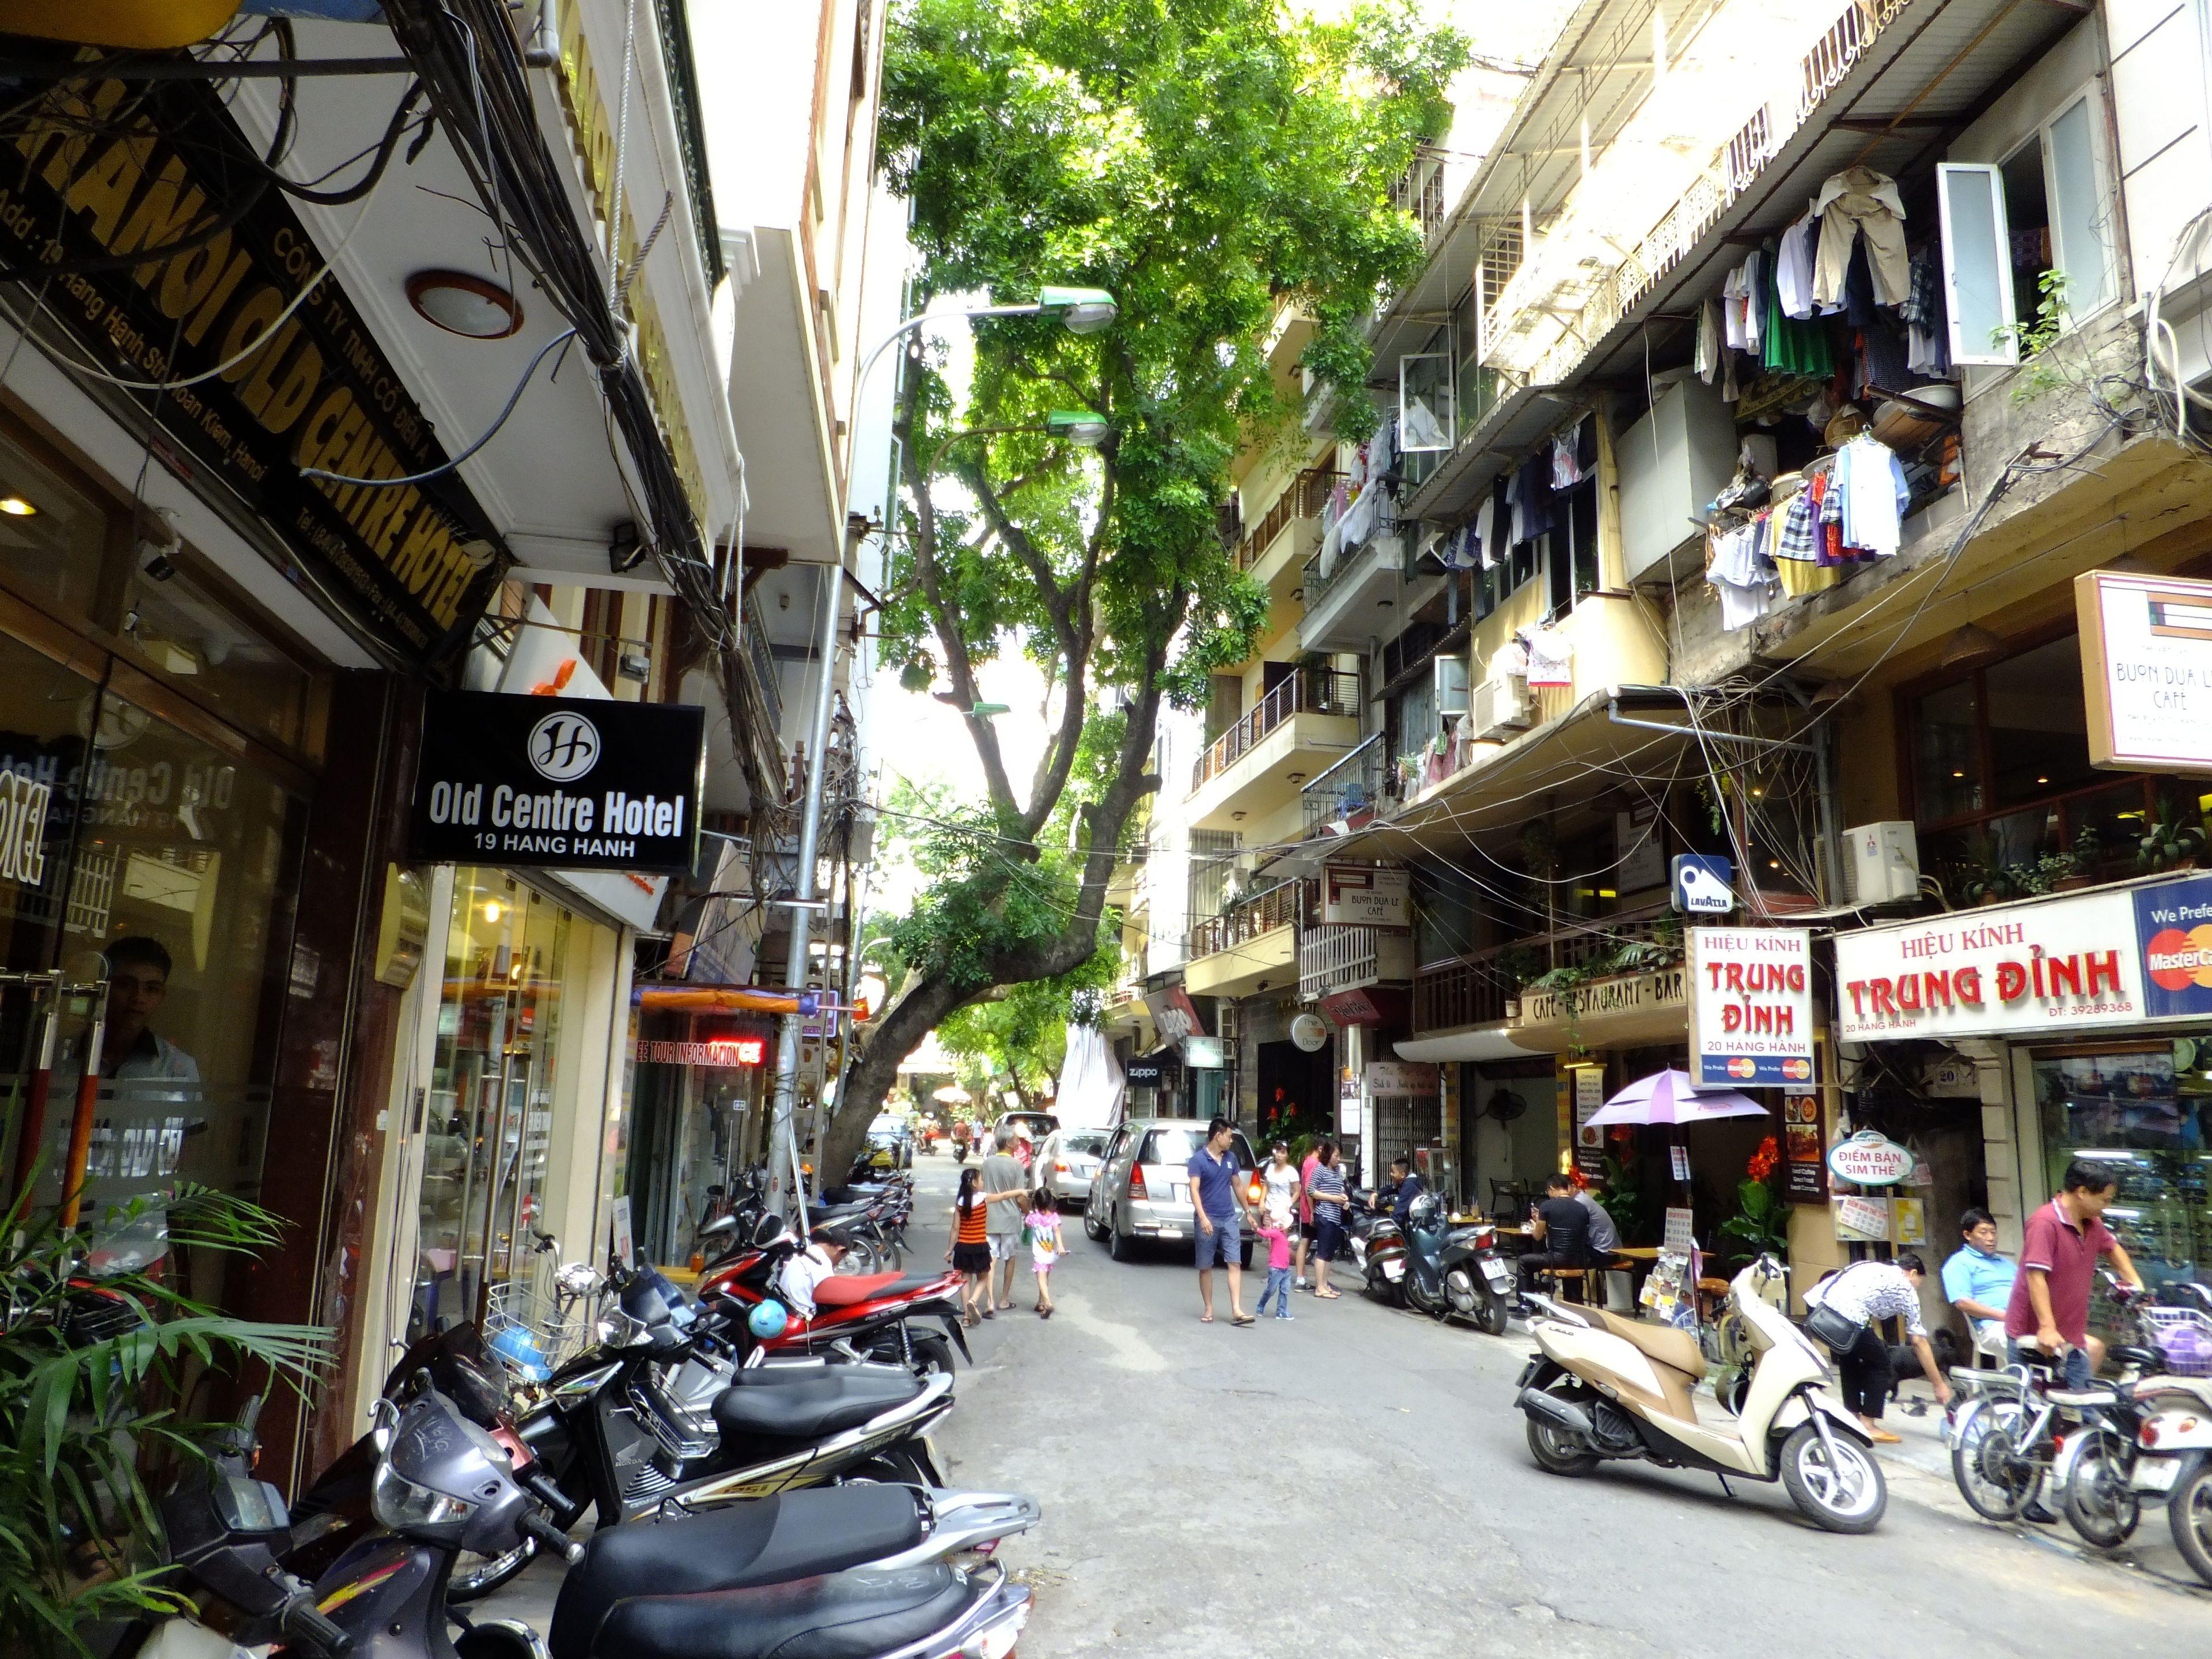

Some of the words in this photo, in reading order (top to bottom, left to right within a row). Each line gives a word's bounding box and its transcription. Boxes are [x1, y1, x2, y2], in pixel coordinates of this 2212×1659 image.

[273, 227, 327, 305] CÔNG
[219, 286, 323, 434] OLD
[294, 386, 421, 567] CENTRE
[397, 504, 485, 631] HOTEL
[429, 781, 483, 825] Old
[491, 785, 594, 832] Centre
[603, 791, 684, 837] Hotel
[474, 833, 497, 850] 19
[503, 835, 567, 854] HANG
[573, 839, 635, 858] HANH
[1691, 896, 1728, 908] LAVAZZA
[2152, 910, 2176, 923] We
[1705, 934, 1748, 954] HIỆU
[1756, 935, 1801, 952] KÍNH
[1902, 932, 1953, 960] HIỆU
[1961, 923, 2024, 950] KÍNH
[1655, 972, 1683, 1001] BAR
[1706, 963, 1804, 992] TRUNG
[1847, 965, 1983, 1016] TRUNG
[2049, 1006, 2067, 1017] ĐT:
[2070, 1002, 2133, 1016] 39289368
[1846, 1024, 1856, 1032] 20
[1302, 1037, 1320, 1046] Door
[1707, 1041, 1722, 1051] 20
[650, 1041, 676, 1063] TOUR
[676, 1041, 740, 1067] INFORMATION
[1940, 1070, 1955, 1082] 20
[1839, 1149, 1871, 1161] ĐIỂM
[1846, 1164, 1868, 1174] SIM
